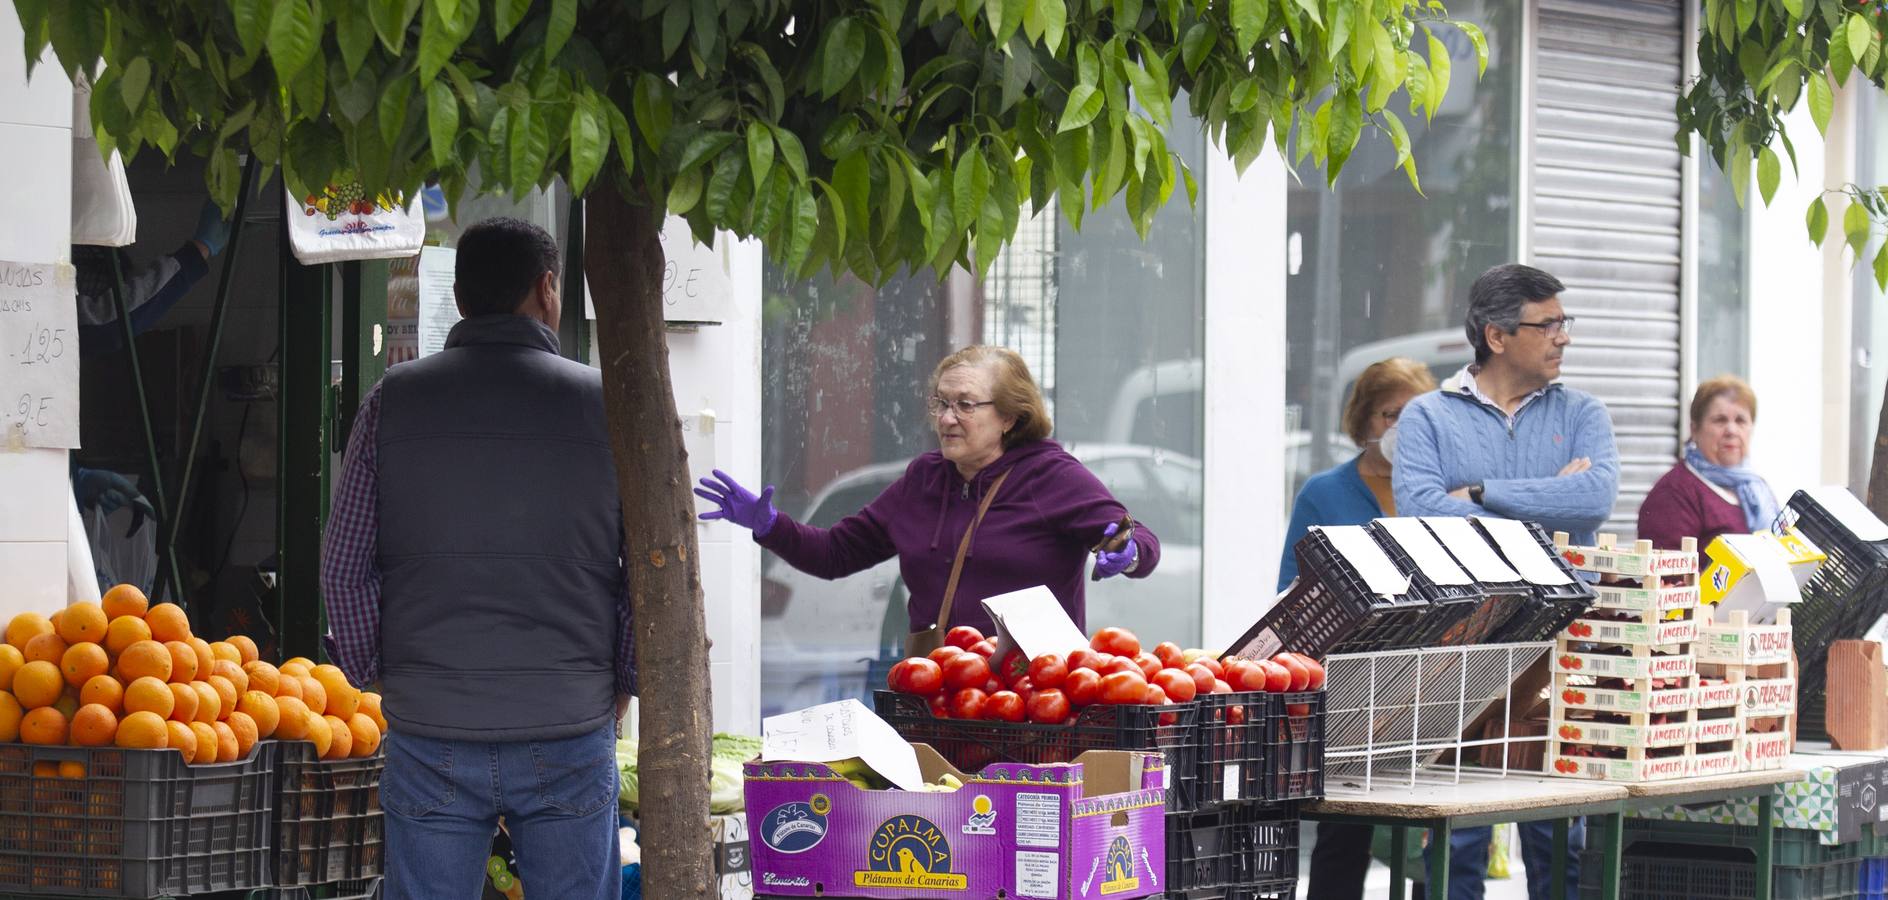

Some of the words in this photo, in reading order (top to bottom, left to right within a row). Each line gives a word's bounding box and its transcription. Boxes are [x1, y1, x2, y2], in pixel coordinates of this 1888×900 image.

[872, 818, 948, 863] COPALMA
[863, 873, 902, 885] Plátanos
[904, 875, 916, 885] de
[918, 875, 960, 887] Canarias
